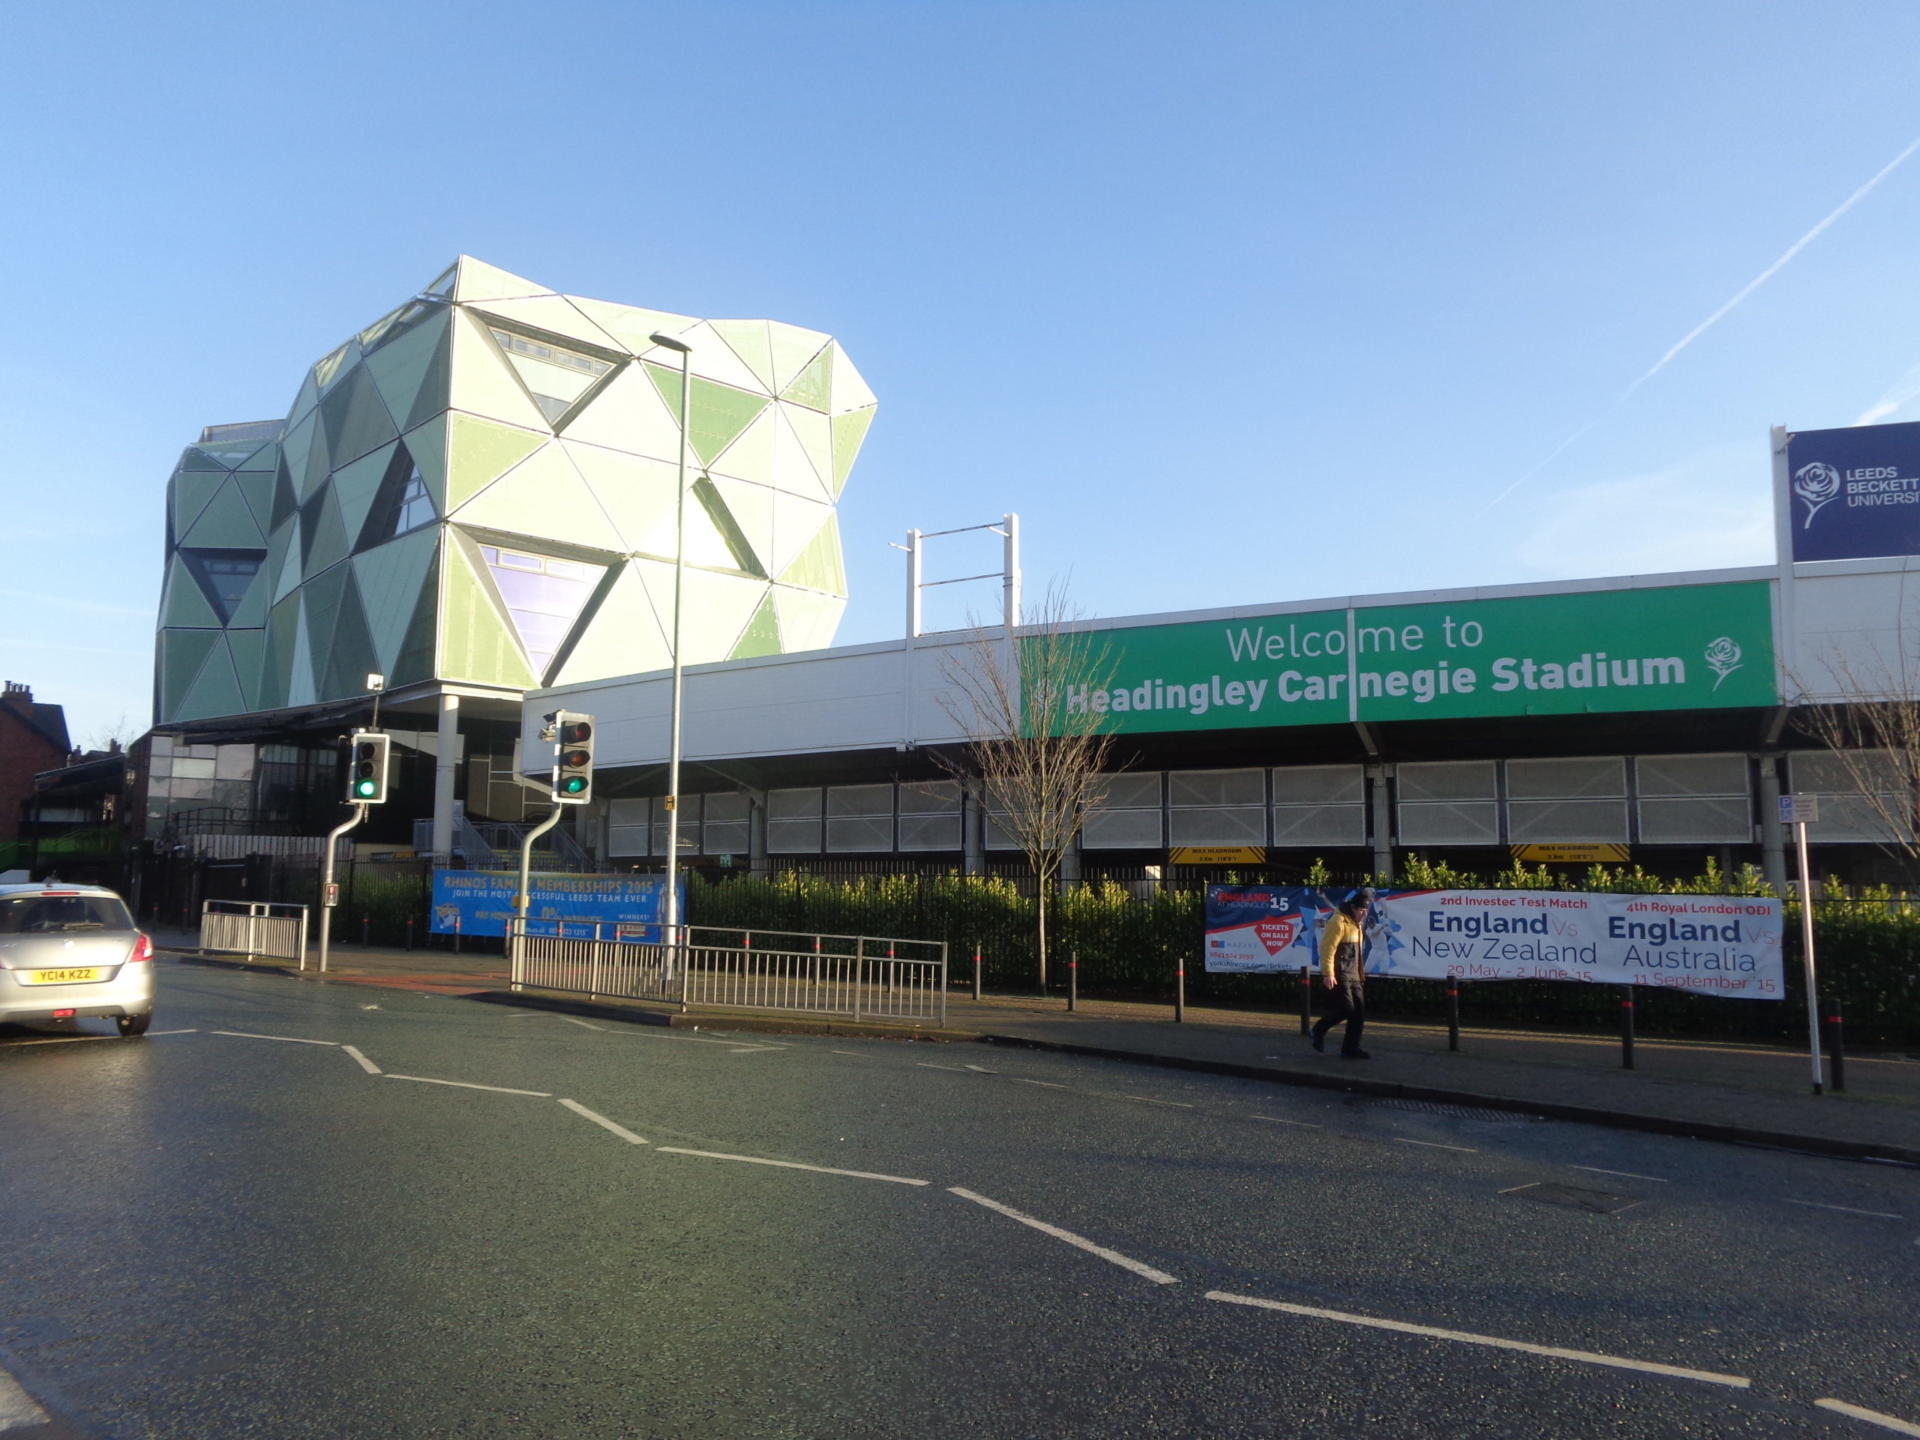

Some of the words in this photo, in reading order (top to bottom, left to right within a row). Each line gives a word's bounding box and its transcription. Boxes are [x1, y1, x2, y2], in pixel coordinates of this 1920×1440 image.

[1846, 467, 1898, 481] LEEDS
[1847, 478, 1919, 494] BECKETT
[1847, 492, 1920, 507] UNIVERSI
[1226, 623, 1425, 662] Welcome
[1442, 614, 1484, 648] to
[1066, 675, 1268, 715] Headingley
[1278, 661, 1477, 703] Carnegie
[1491, 650, 1687, 693] Stadium
[444, 876, 486, 890] RHINOS
[489, 878, 531, 891] FAMIY
[536, 880, 622, 894] MEMBERSHIPS
[627, 881, 654, 894] 2015
[452, 889, 471, 898] JOIN
[473, 890, 489, 898] THE
[491, 890, 511, 899] MOST
[514, 891, 565, 901] SCESSFUL
[568, 894, 593, 902] LEEDS
[597, 894, 621, 903] TEAM
[625, 895, 647, 903] EVER
[1440, 896, 1462, 906] 2nd
[1465, 896, 1516, 907] Investec
[1519, 897, 1547, 907] Test
[1549, 898, 1588, 909] Match
[1627, 902, 1648, 912] 4th
[1651, 902, 1687, 915] Royal
[1691, 903, 1742, 915] London
[1745, 905, 1771, 916] ODI
[1429, 911, 1548, 938] England
[1551, 919, 1578, 936] Vs
[1608, 916, 1742, 946] England
[1412, 936, 1474, 958] New
[1483, 938, 1597, 964] Zealand
[1623, 945, 1756, 972] Australia
[40, 970, 65, 981] YC14
[69, 969, 91, 979] KZZ
[1447, 964, 1465, 977] 29
[1469, 963, 1501, 978] May
[1517, 967, 1525, 977] 2
[1533, 967, 1568, 979] June
[1633, 974, 1648, 985] 11
[1653, 972, 1748, 989] September
